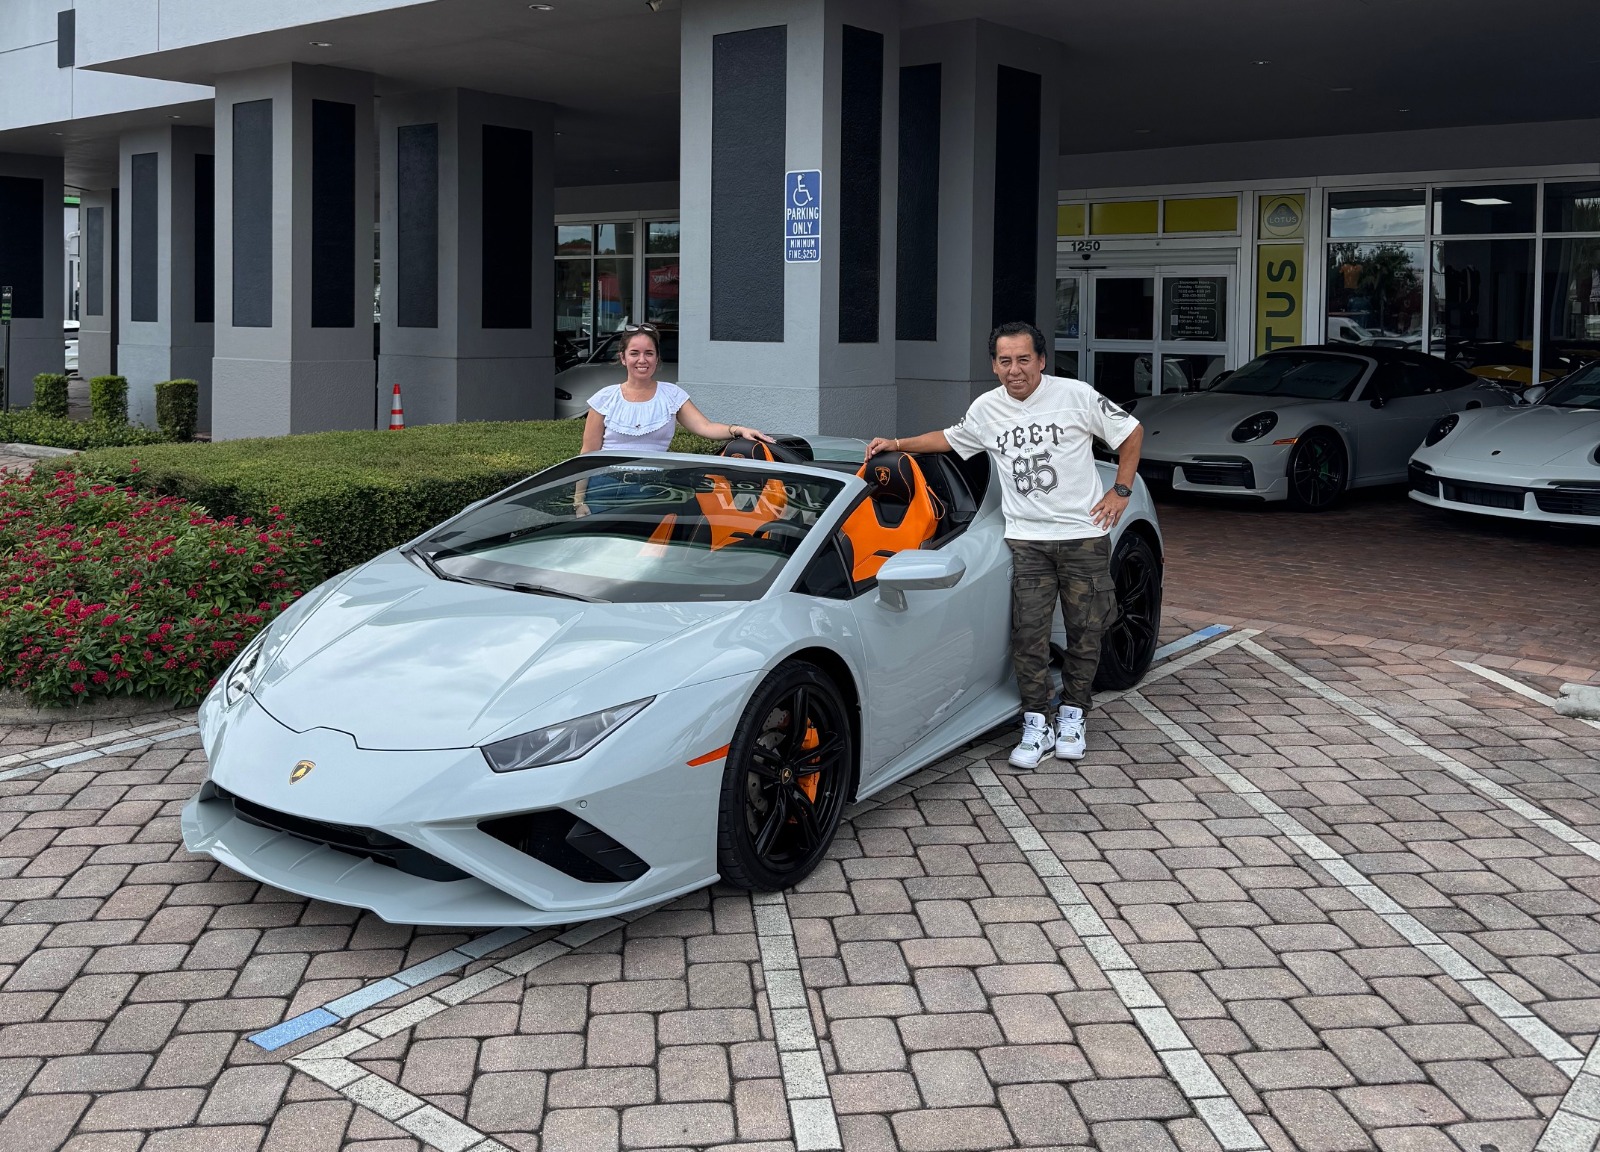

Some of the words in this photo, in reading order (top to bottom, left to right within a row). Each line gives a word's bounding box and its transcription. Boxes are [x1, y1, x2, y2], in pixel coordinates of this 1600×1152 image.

[787, 207, 819, 220] PARKING
[793, 222, 812, 234] ONLY
[791, 239, 815, 248] MINIMUM
[1072, 240, 1101, 252] 1250
[789, 250, 802, 258] FINE
[802, 249, 817, 259] $250
[996, 422, 1064, 455] YEET
[1012, 449, 1059, 497] 85
